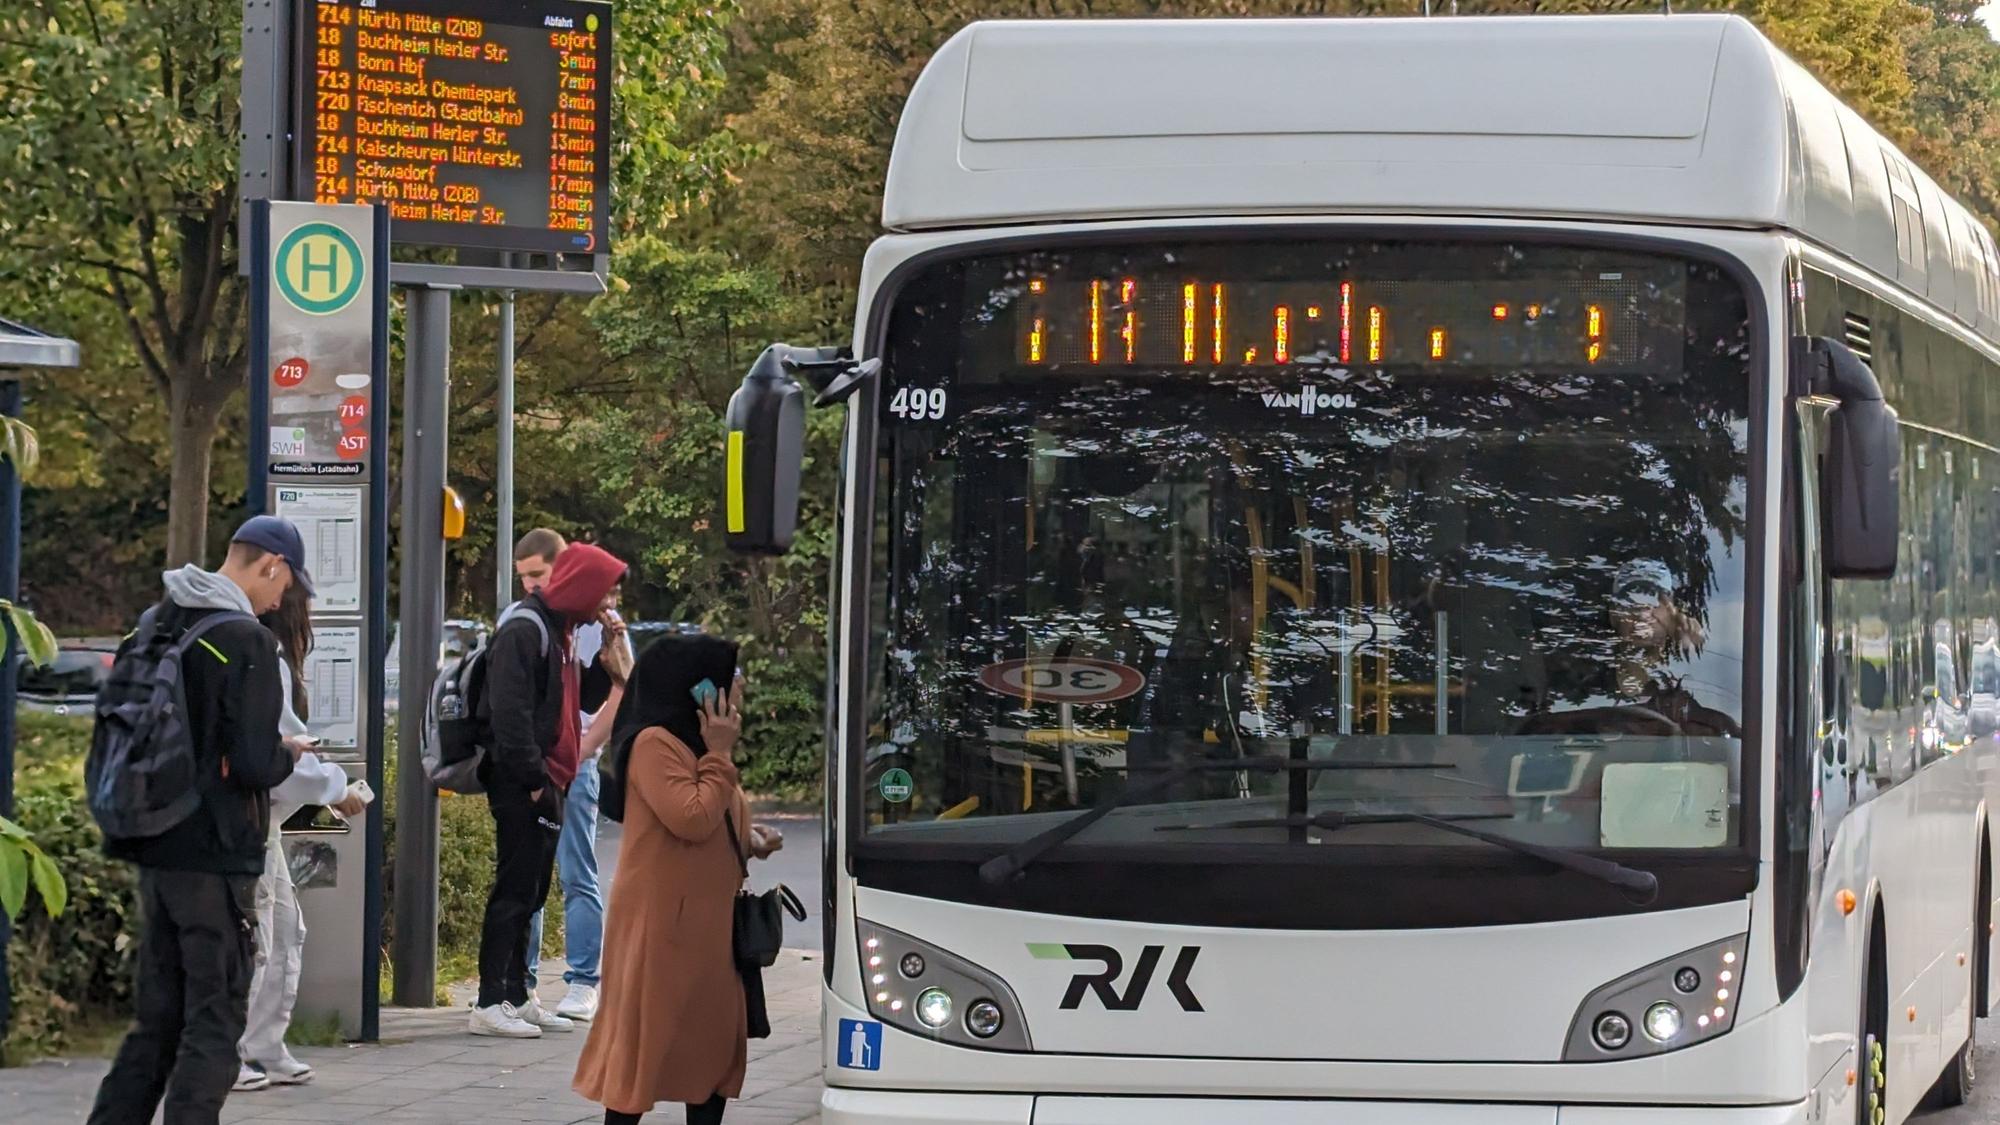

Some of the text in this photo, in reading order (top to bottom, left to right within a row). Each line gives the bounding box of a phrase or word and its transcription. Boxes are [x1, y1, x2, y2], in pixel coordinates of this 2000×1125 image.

[317, 4, 596, 51] 714 Hürth Mitte (ZOB) sofort
[544, 15, 573, 28] Abfahrt
[317, 27, 596, 70] 18 Buchheim Herler Str. 3min
[317, 49, 596, 90] 18 Bonn Hbf 7min
[317, 70, 595, 111] 713 Knapsack Chemiepark 8min
[316, 91, 595, 131] 720 Fischenich (Stadtbahn) 11min
[316, 113, 595, 152] 18 Buchheim Herler Str. 13min
[316, 135, 594, 173] 714 Kalscheuren Winterstr. 14min
[316, 156, 594, 193] 18 Schwadorf 17min
[315, 176, 593, 212] 714 Hürth Mitte (ZOB) 18min
[432, 204, 477, 223] Herler
[482, 208, 506, 225] Str.
[548, 212, 592, 231] 23min
[301, 243, 338, 293] H
[281, 365, 302, 379] 713
[339, 405, 364, 418] 714
[889, 387, 947, 420] 499
[271, 442, 303, 455] SWH
[340, 436, 367, 450] AST
[1025, 943, 1205, 1012] RVK
